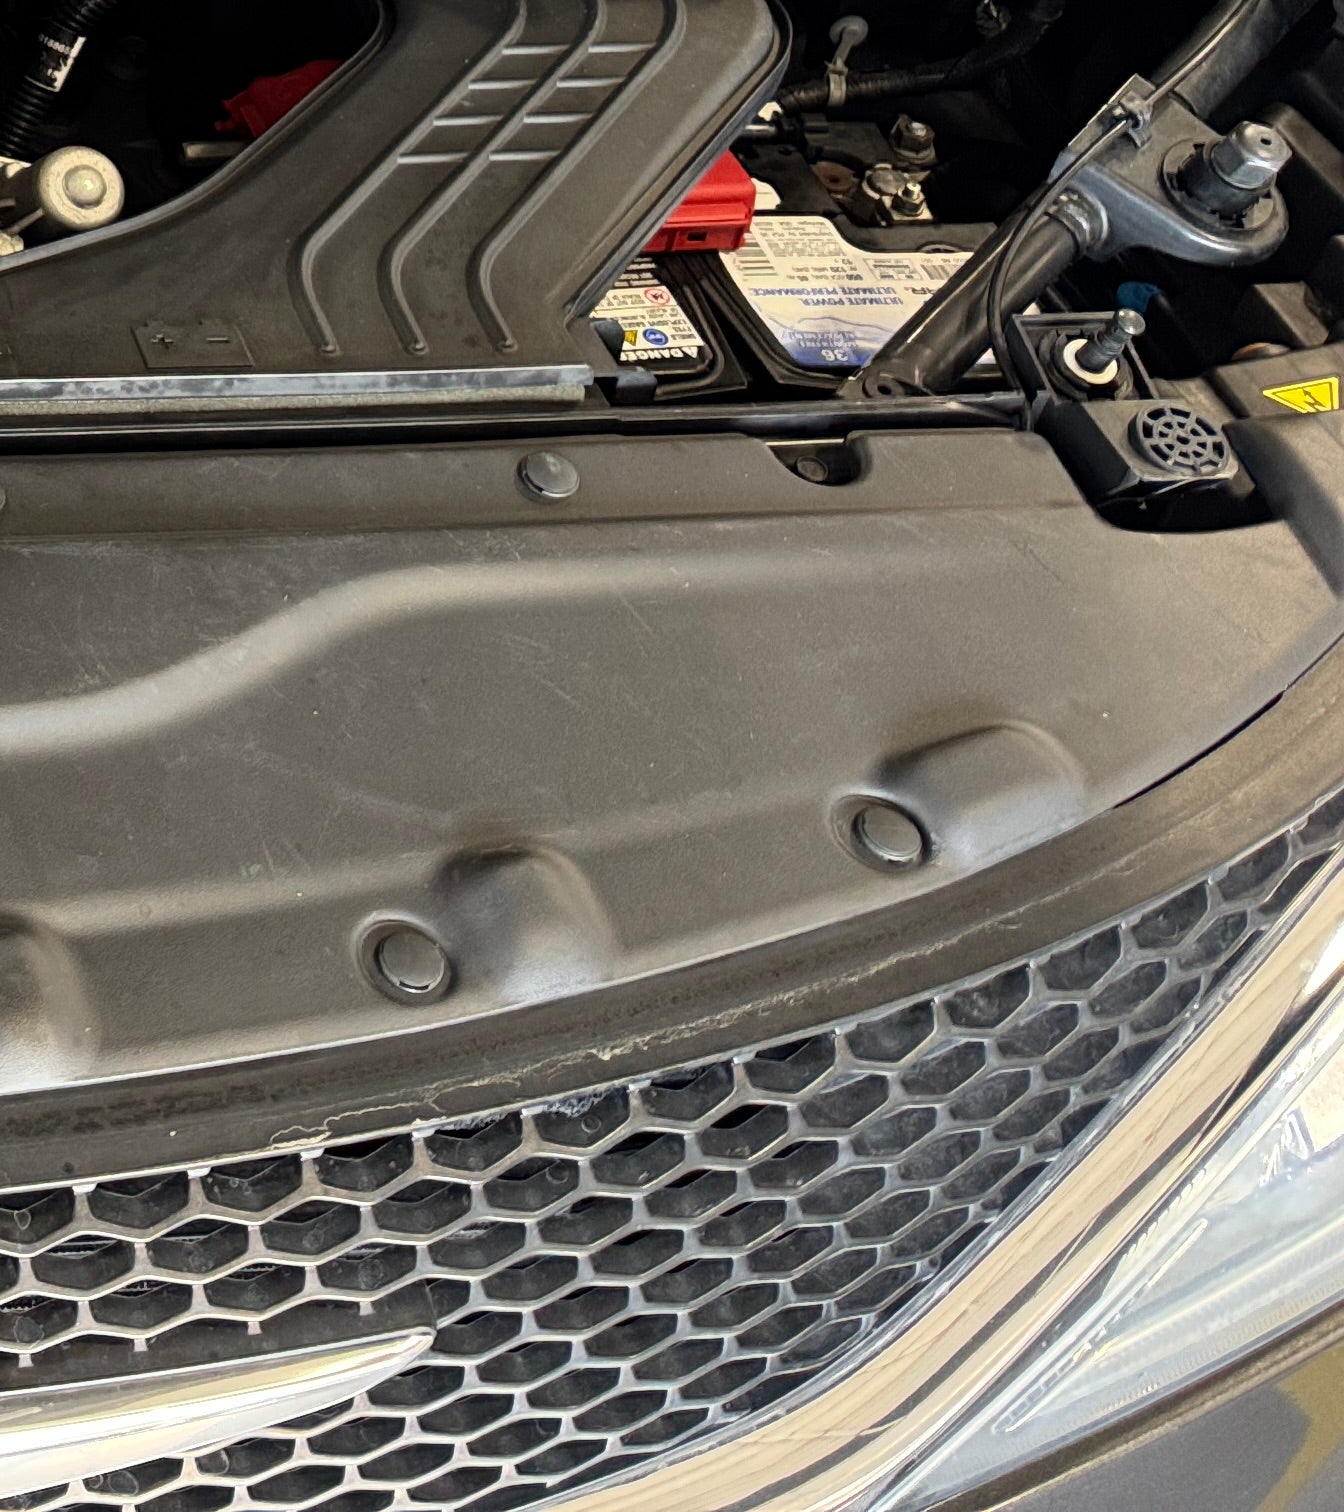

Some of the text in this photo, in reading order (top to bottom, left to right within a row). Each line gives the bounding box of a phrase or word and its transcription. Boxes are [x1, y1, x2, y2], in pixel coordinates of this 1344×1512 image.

[838, 285, 898, 296] ULTIMATE
[846, 295, 905, 306] ULTIMATE
[821, 348, 850, 362] 36
